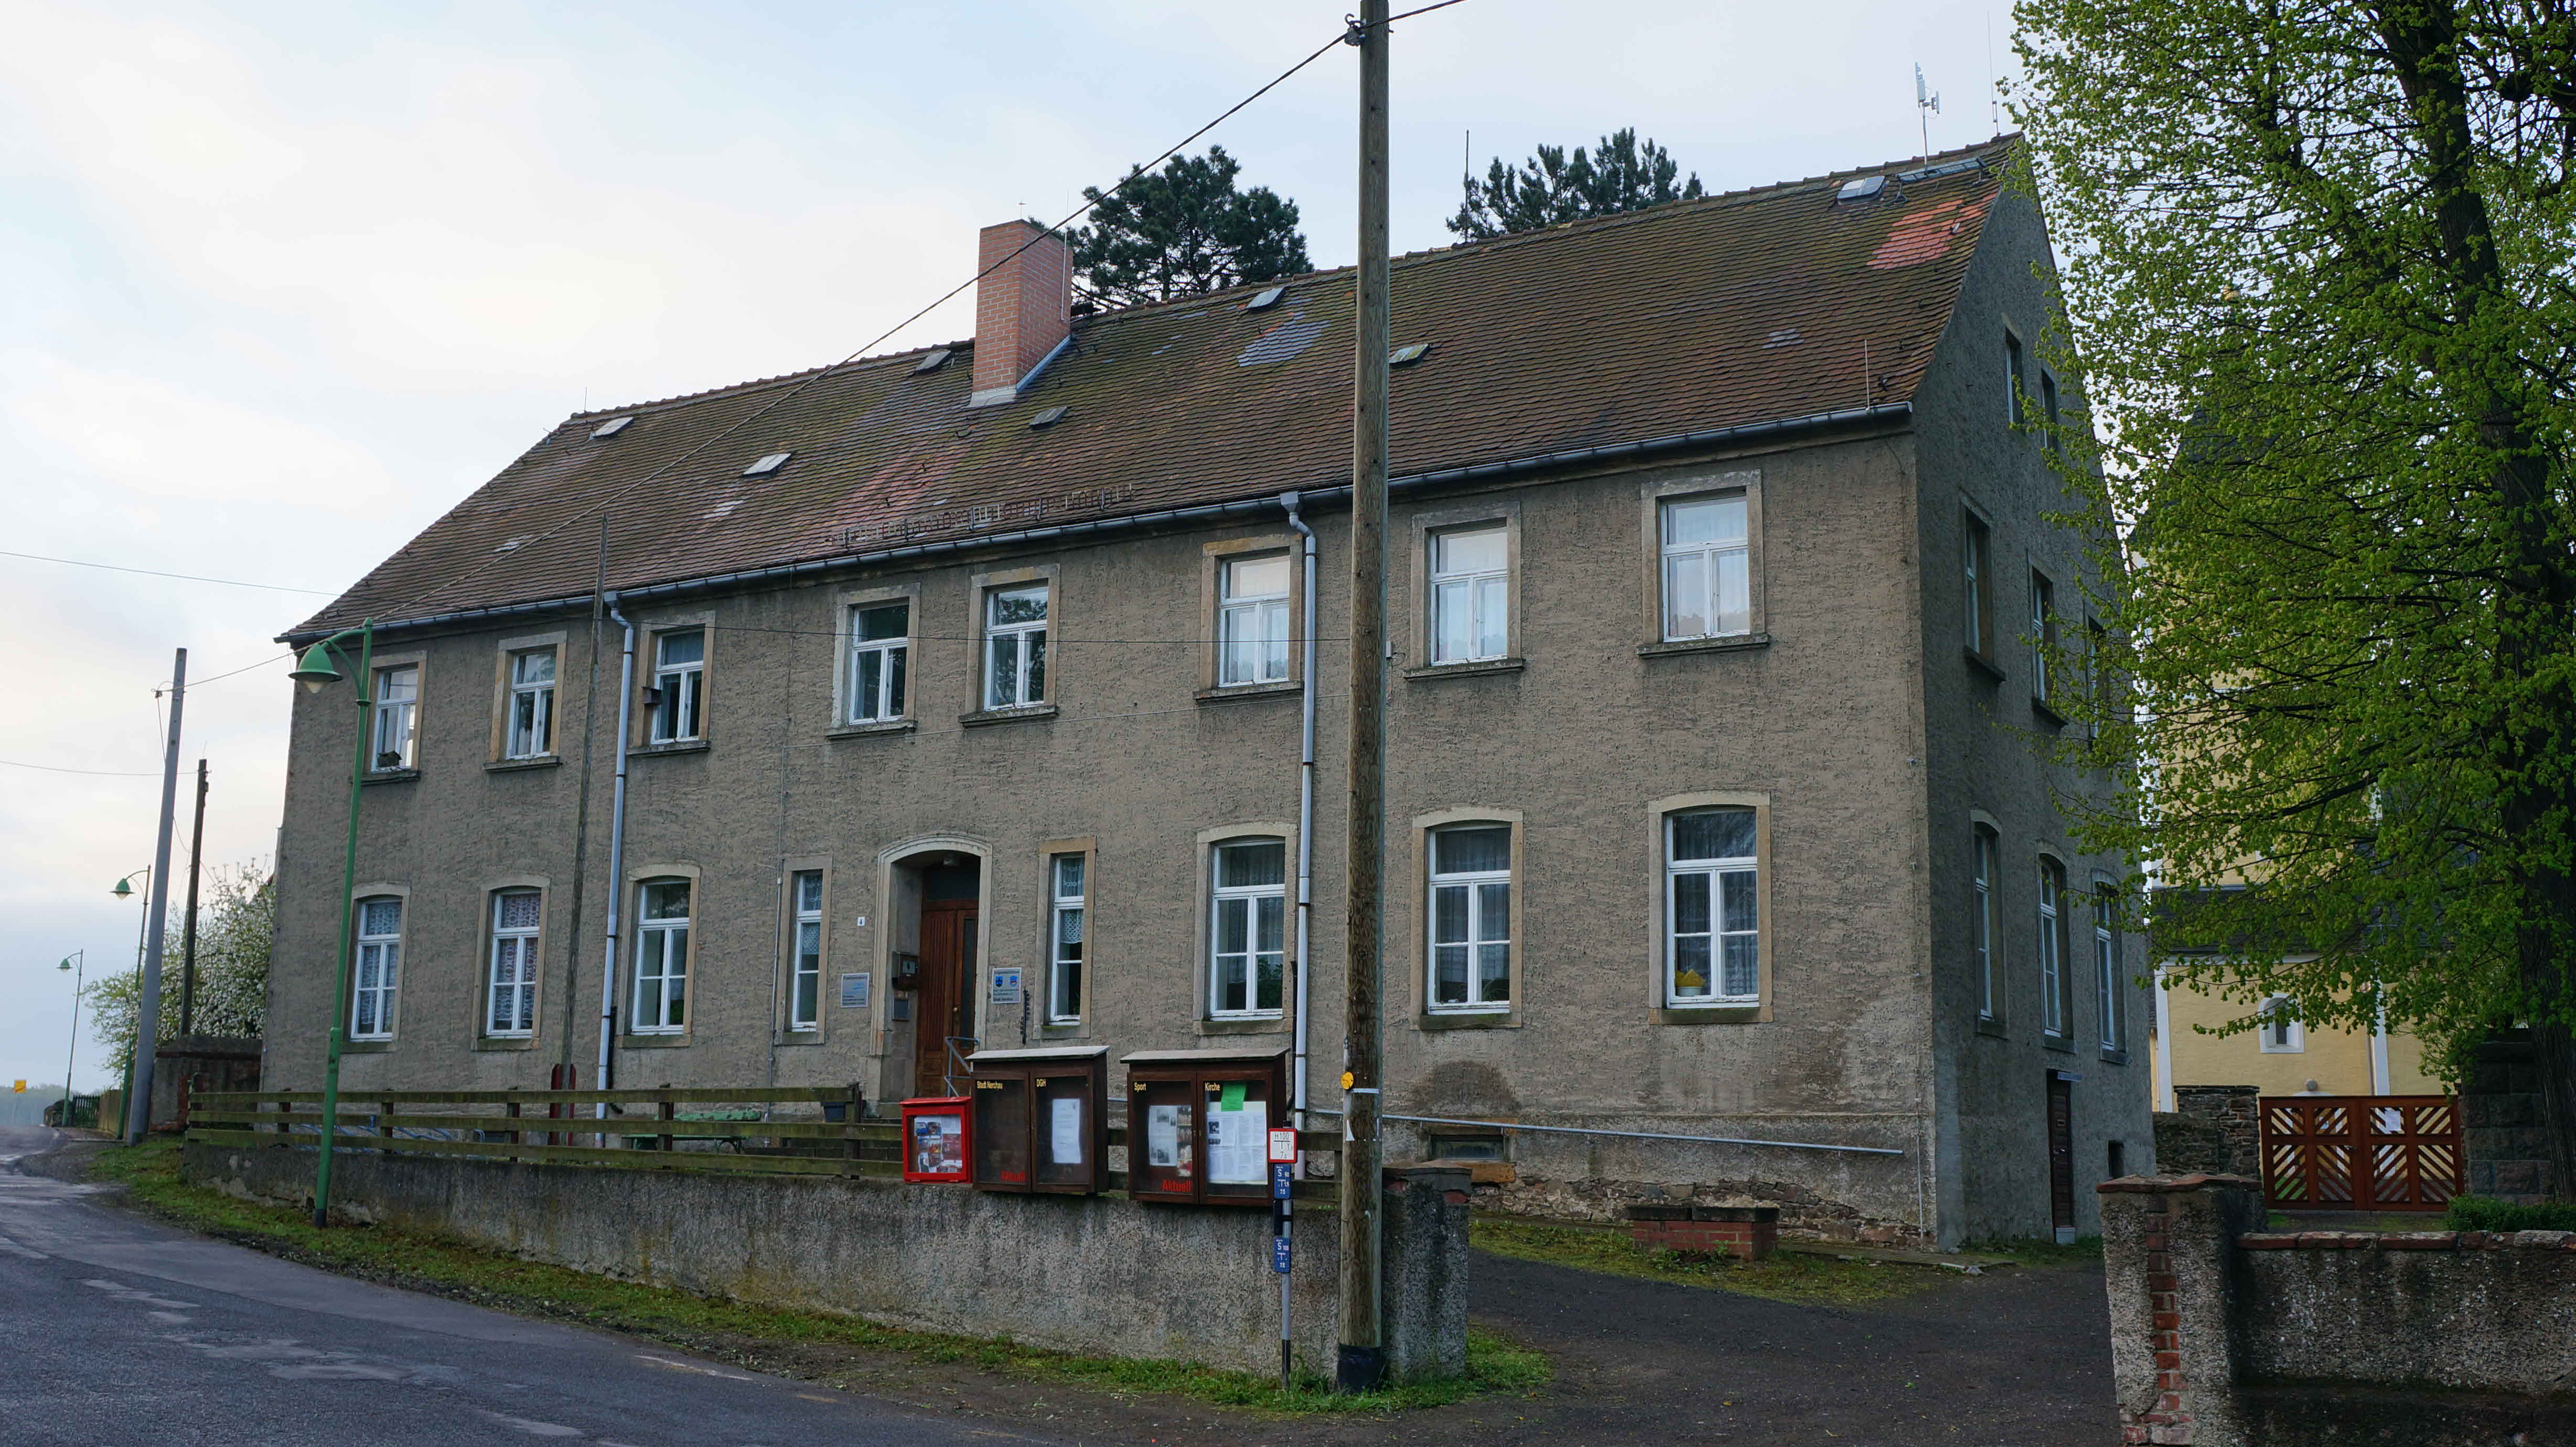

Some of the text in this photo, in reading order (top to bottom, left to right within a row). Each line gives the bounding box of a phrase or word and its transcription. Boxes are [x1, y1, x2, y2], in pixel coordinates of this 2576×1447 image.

[976, 1081, 986, 1089] Stadt
[1036, 1078, 1047, 1088] DGH
[1134, 1082, 1147, 1093] Sport
[1205, 1082, 1221, 1092] Kirche
[1278, 1169, 1282, 1177] S
[1162, 1179, 1192, 1192] Aktuell
[1277, 1242, 1282, 1250] S
